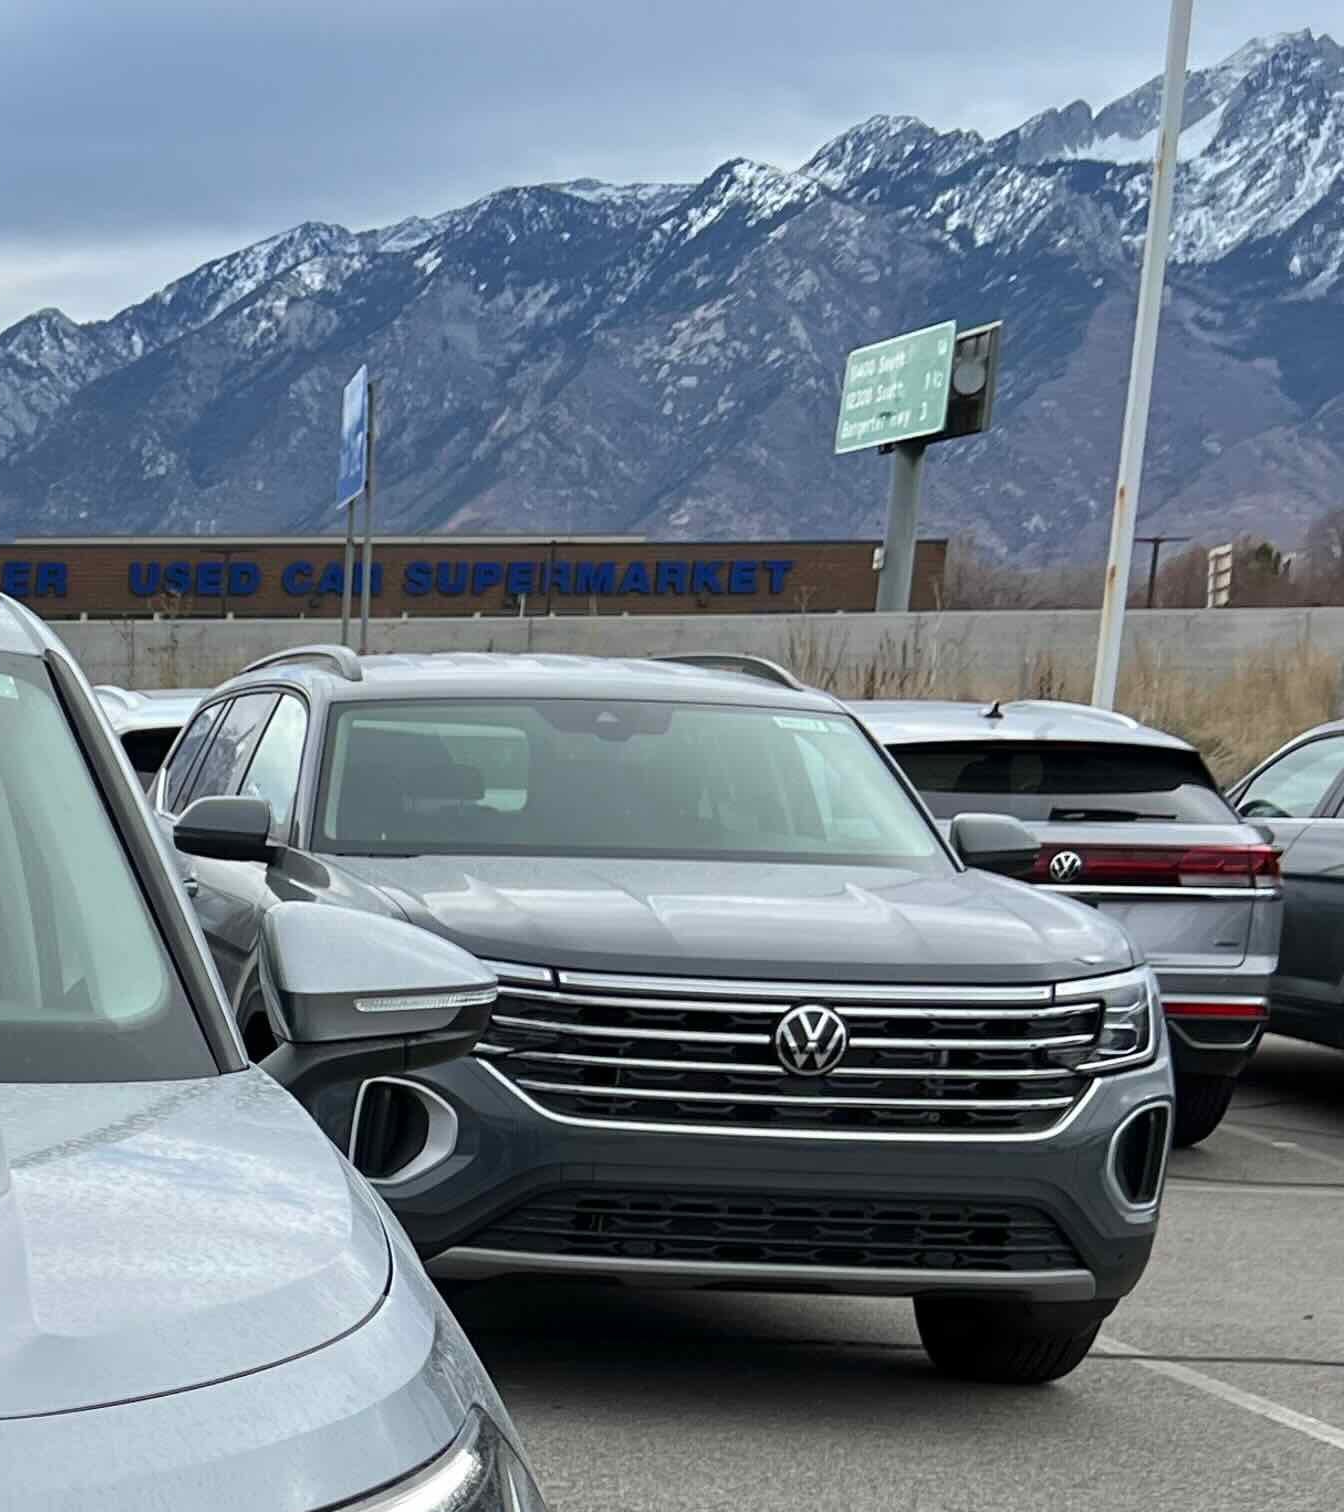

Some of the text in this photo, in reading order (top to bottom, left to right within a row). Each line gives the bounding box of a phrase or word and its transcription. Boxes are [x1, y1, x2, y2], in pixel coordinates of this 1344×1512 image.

[128, 561, 263, 596] USED
[405, 560, 796, 595] SUPERMARKET
[776, 1005, 846, 1076] VW
